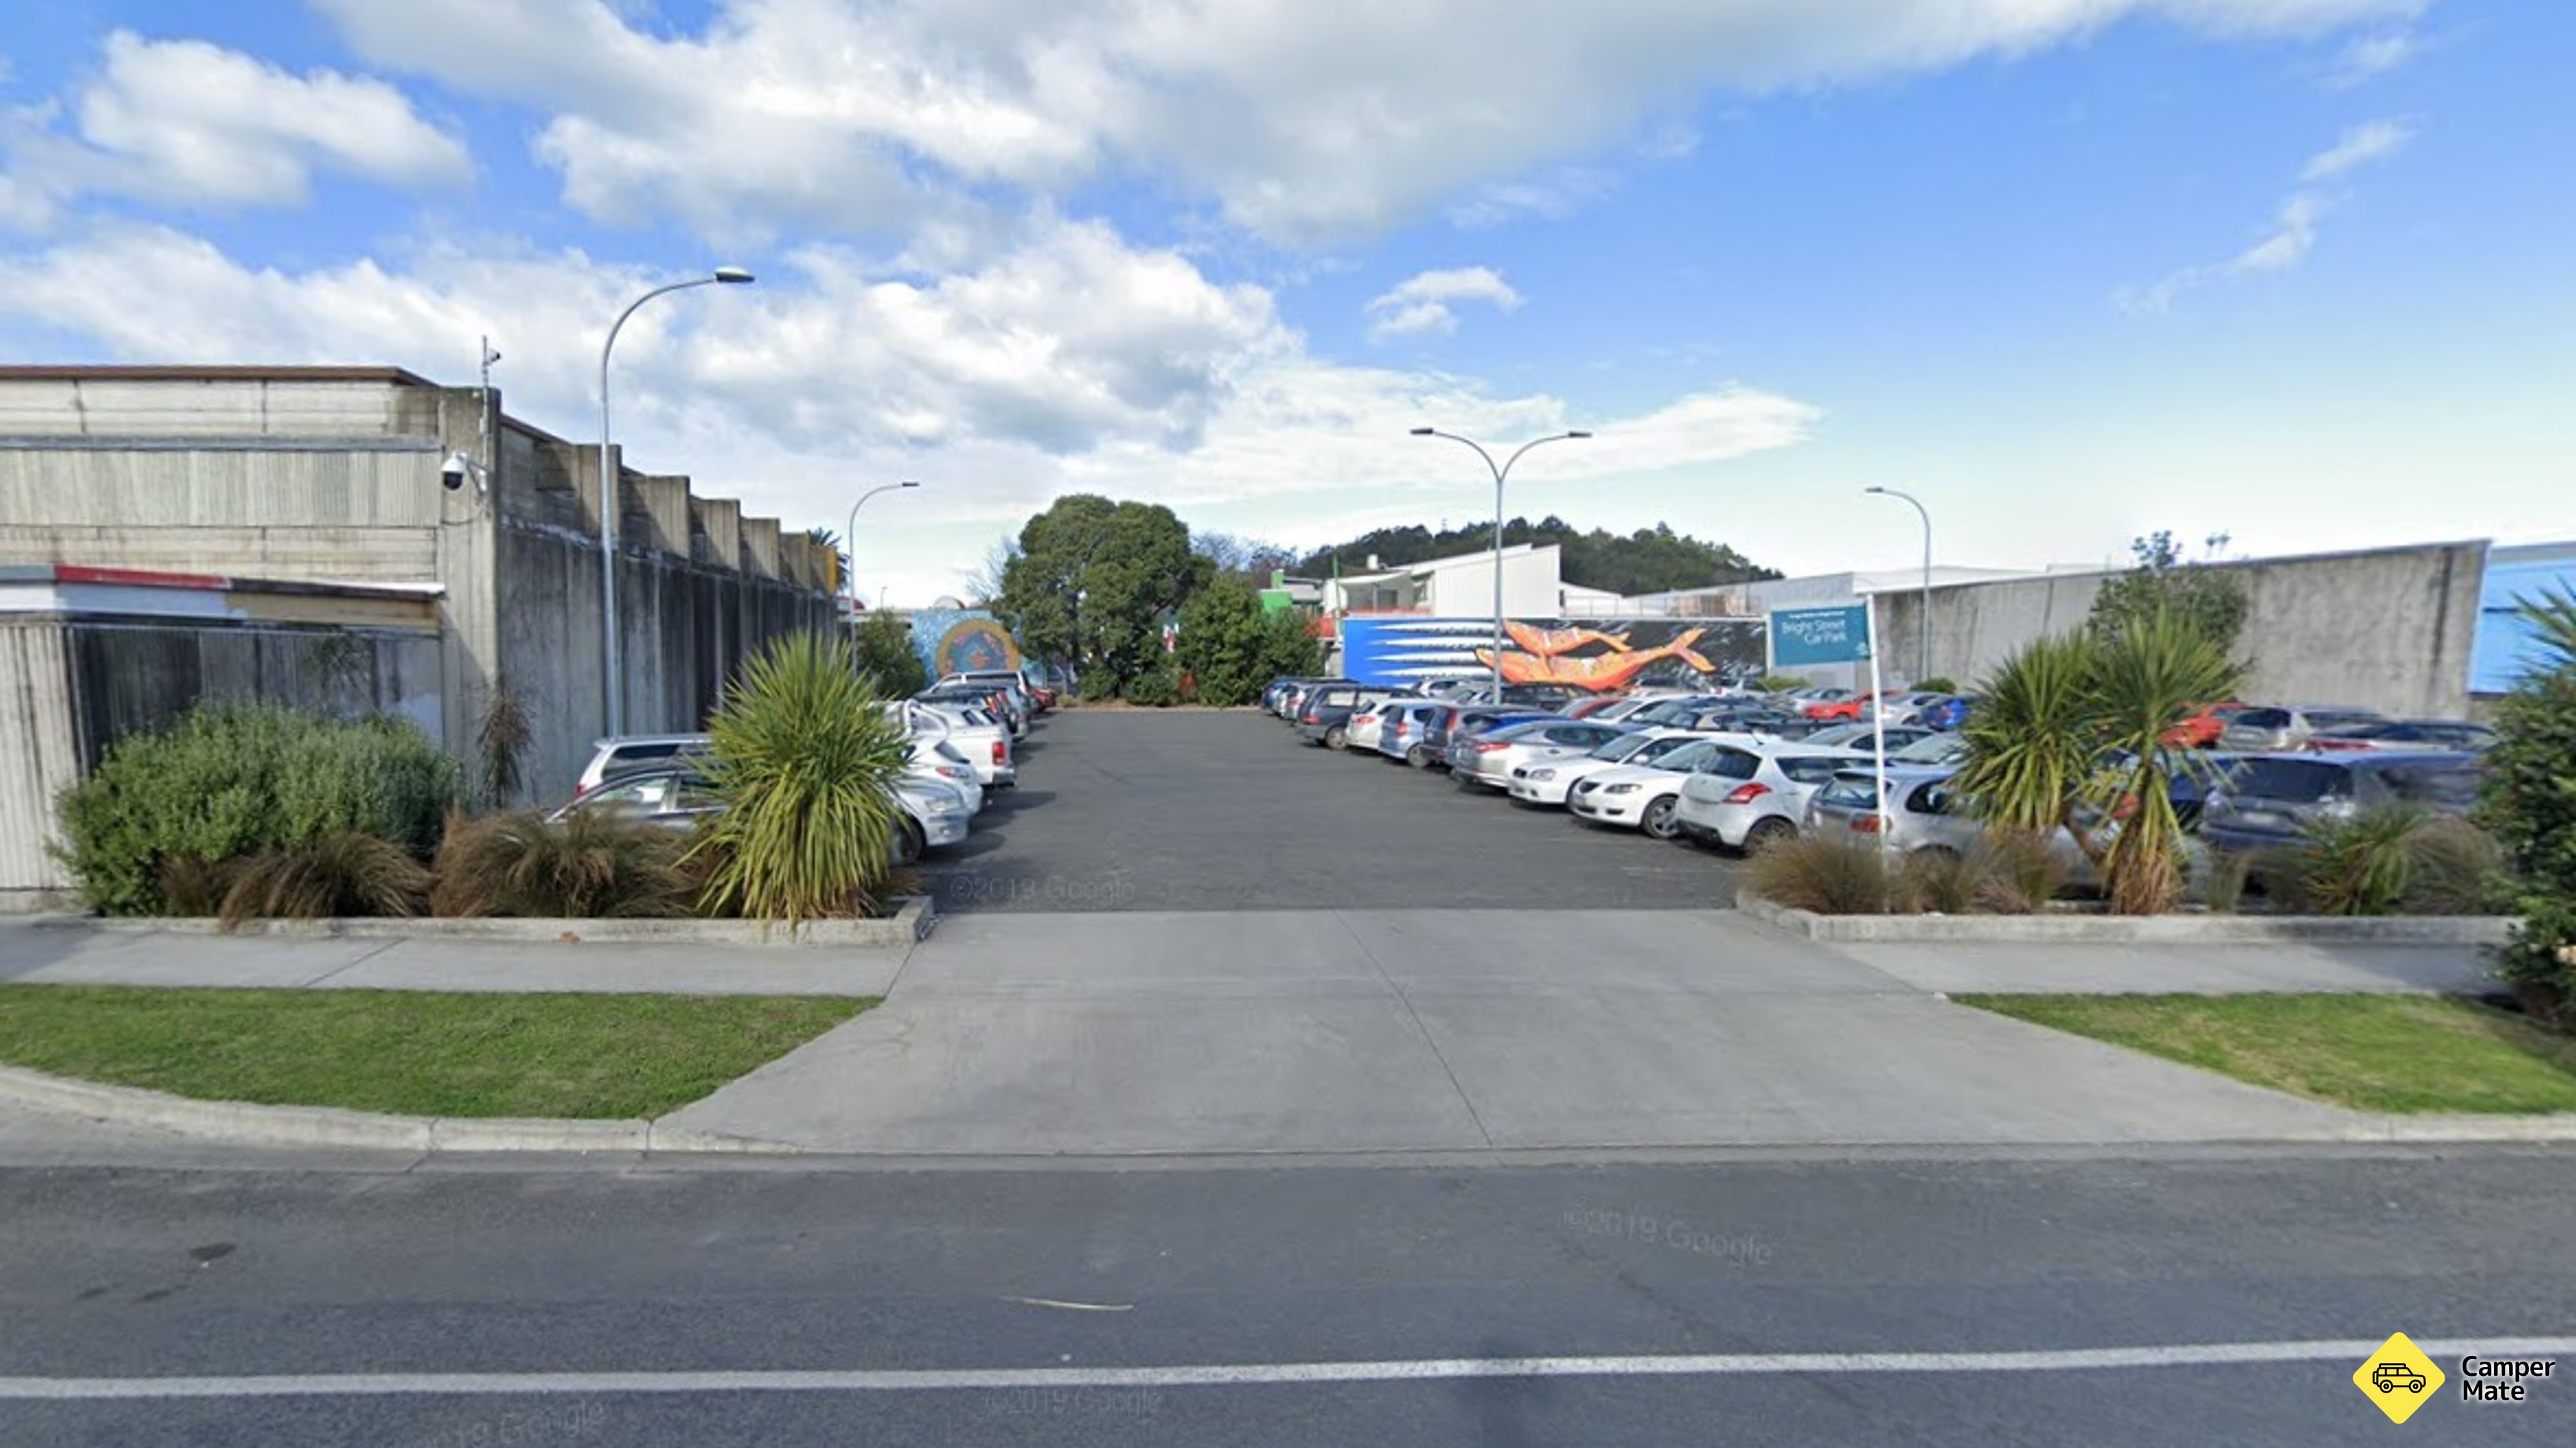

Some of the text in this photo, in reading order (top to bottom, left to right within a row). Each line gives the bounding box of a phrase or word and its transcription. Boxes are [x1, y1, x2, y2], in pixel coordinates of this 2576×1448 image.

[1781, 619, 1846, 635] Bright Street
[1804, 631, 1848, 644] Car Park
